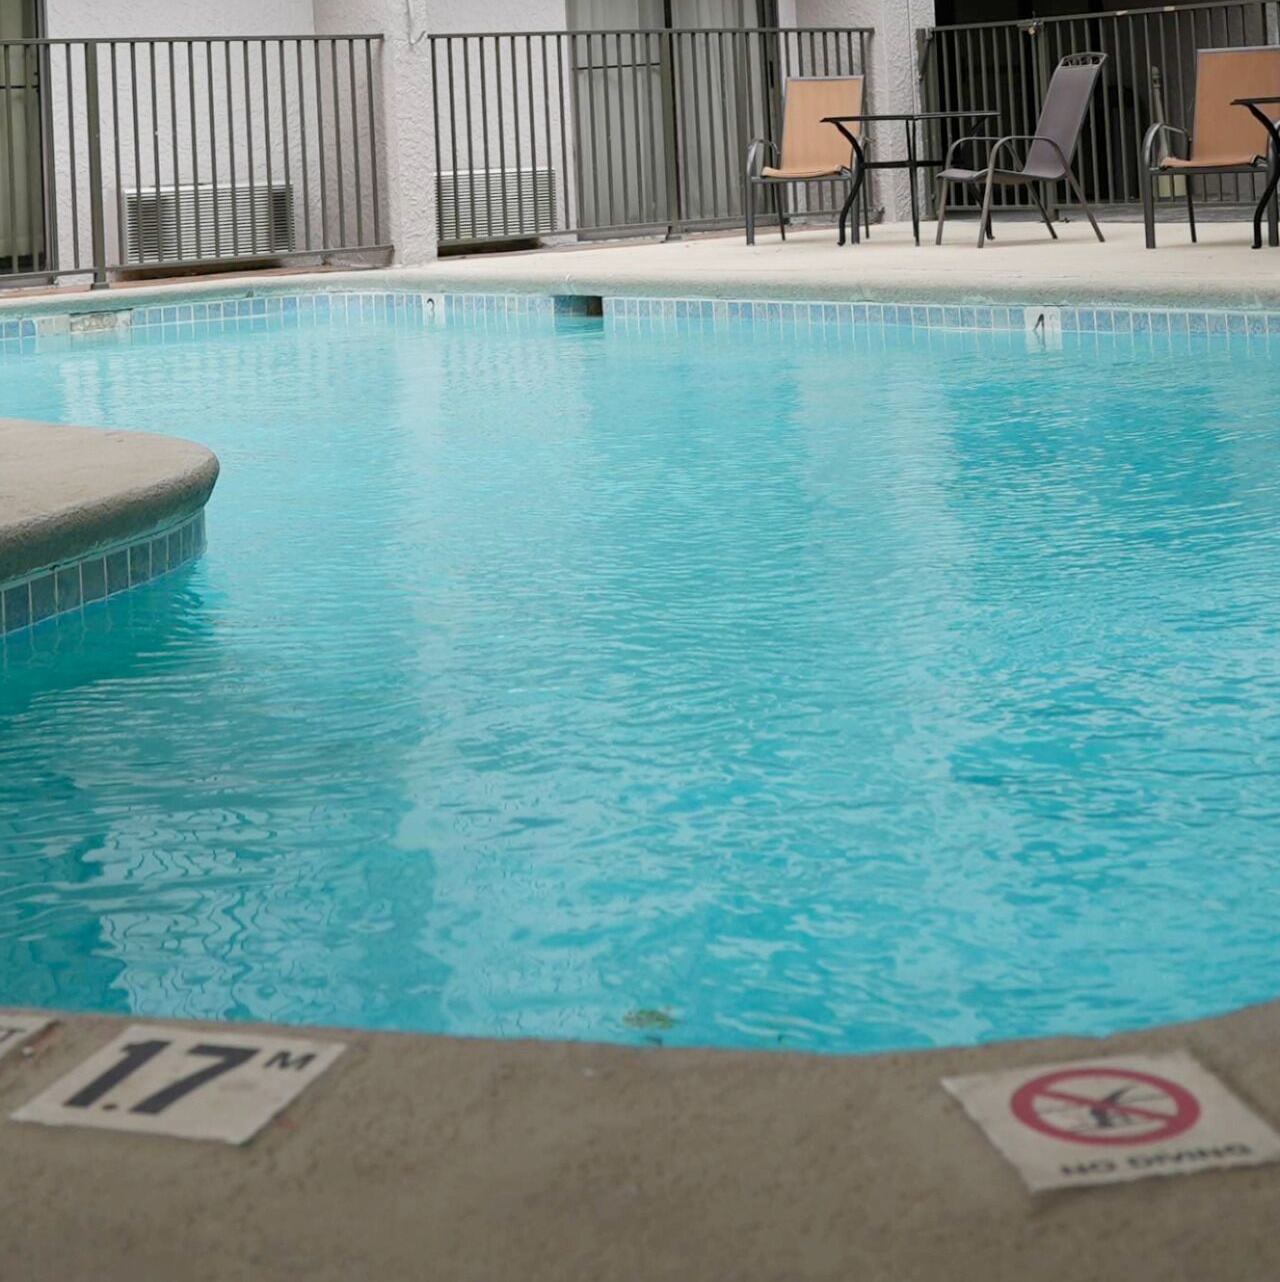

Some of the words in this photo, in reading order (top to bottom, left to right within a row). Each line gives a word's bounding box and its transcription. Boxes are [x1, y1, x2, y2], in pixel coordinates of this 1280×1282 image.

[62, 1039, 262, 1115] 1.7
[265, 1051, 318, 1072] M
[1060, 1158, 1117, 1177] NO
[1127, 1143, 1253, 1168] DIVING
